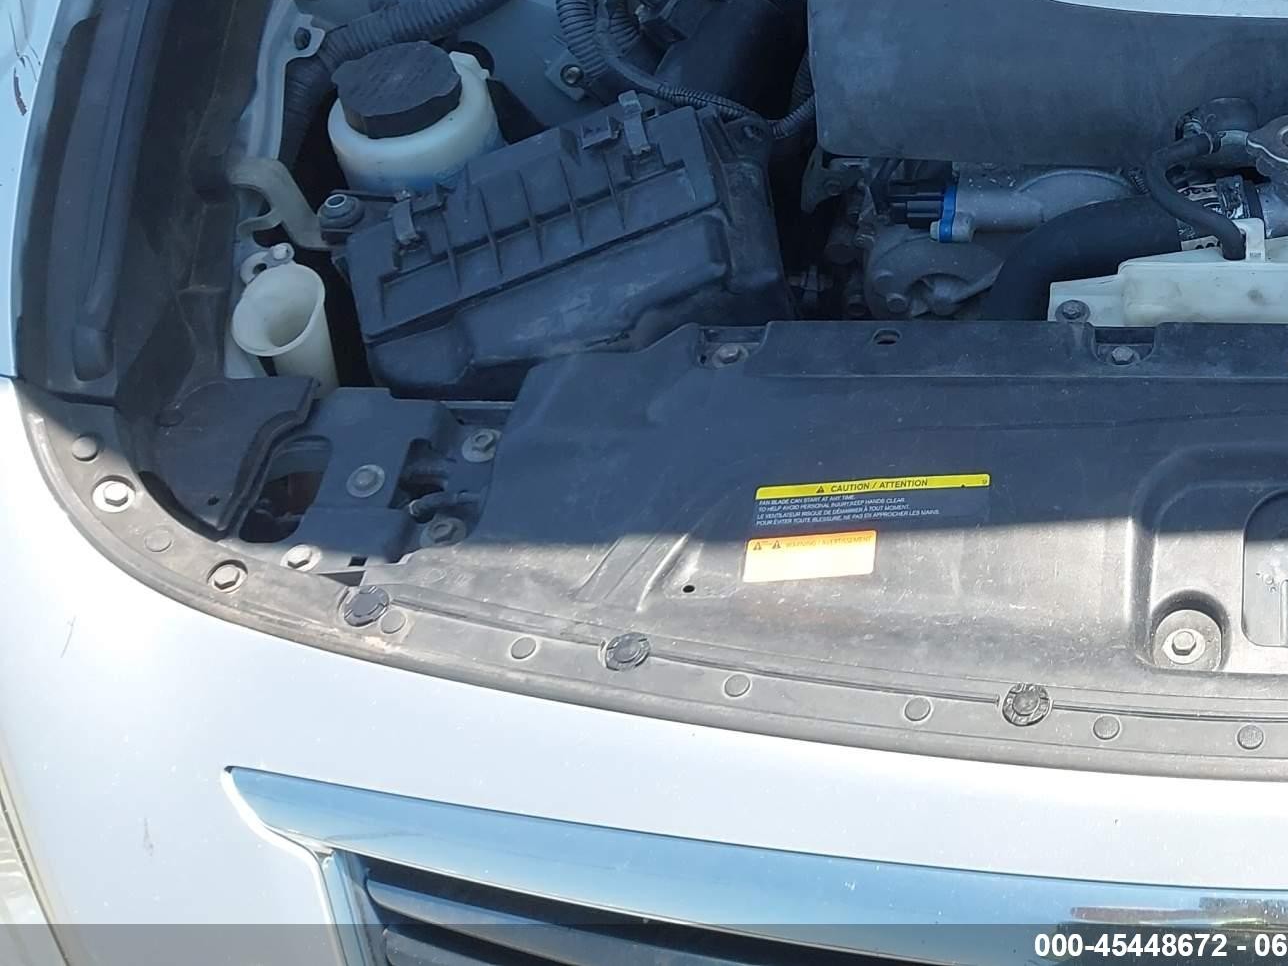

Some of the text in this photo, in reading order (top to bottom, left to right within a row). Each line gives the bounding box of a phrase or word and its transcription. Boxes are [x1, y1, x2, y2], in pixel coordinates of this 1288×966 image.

[830, 482, 870, 493] CAUTION
[879, 478, 928, 489] ATTENTION
[800, 502, 830, 510] PERSONAL
